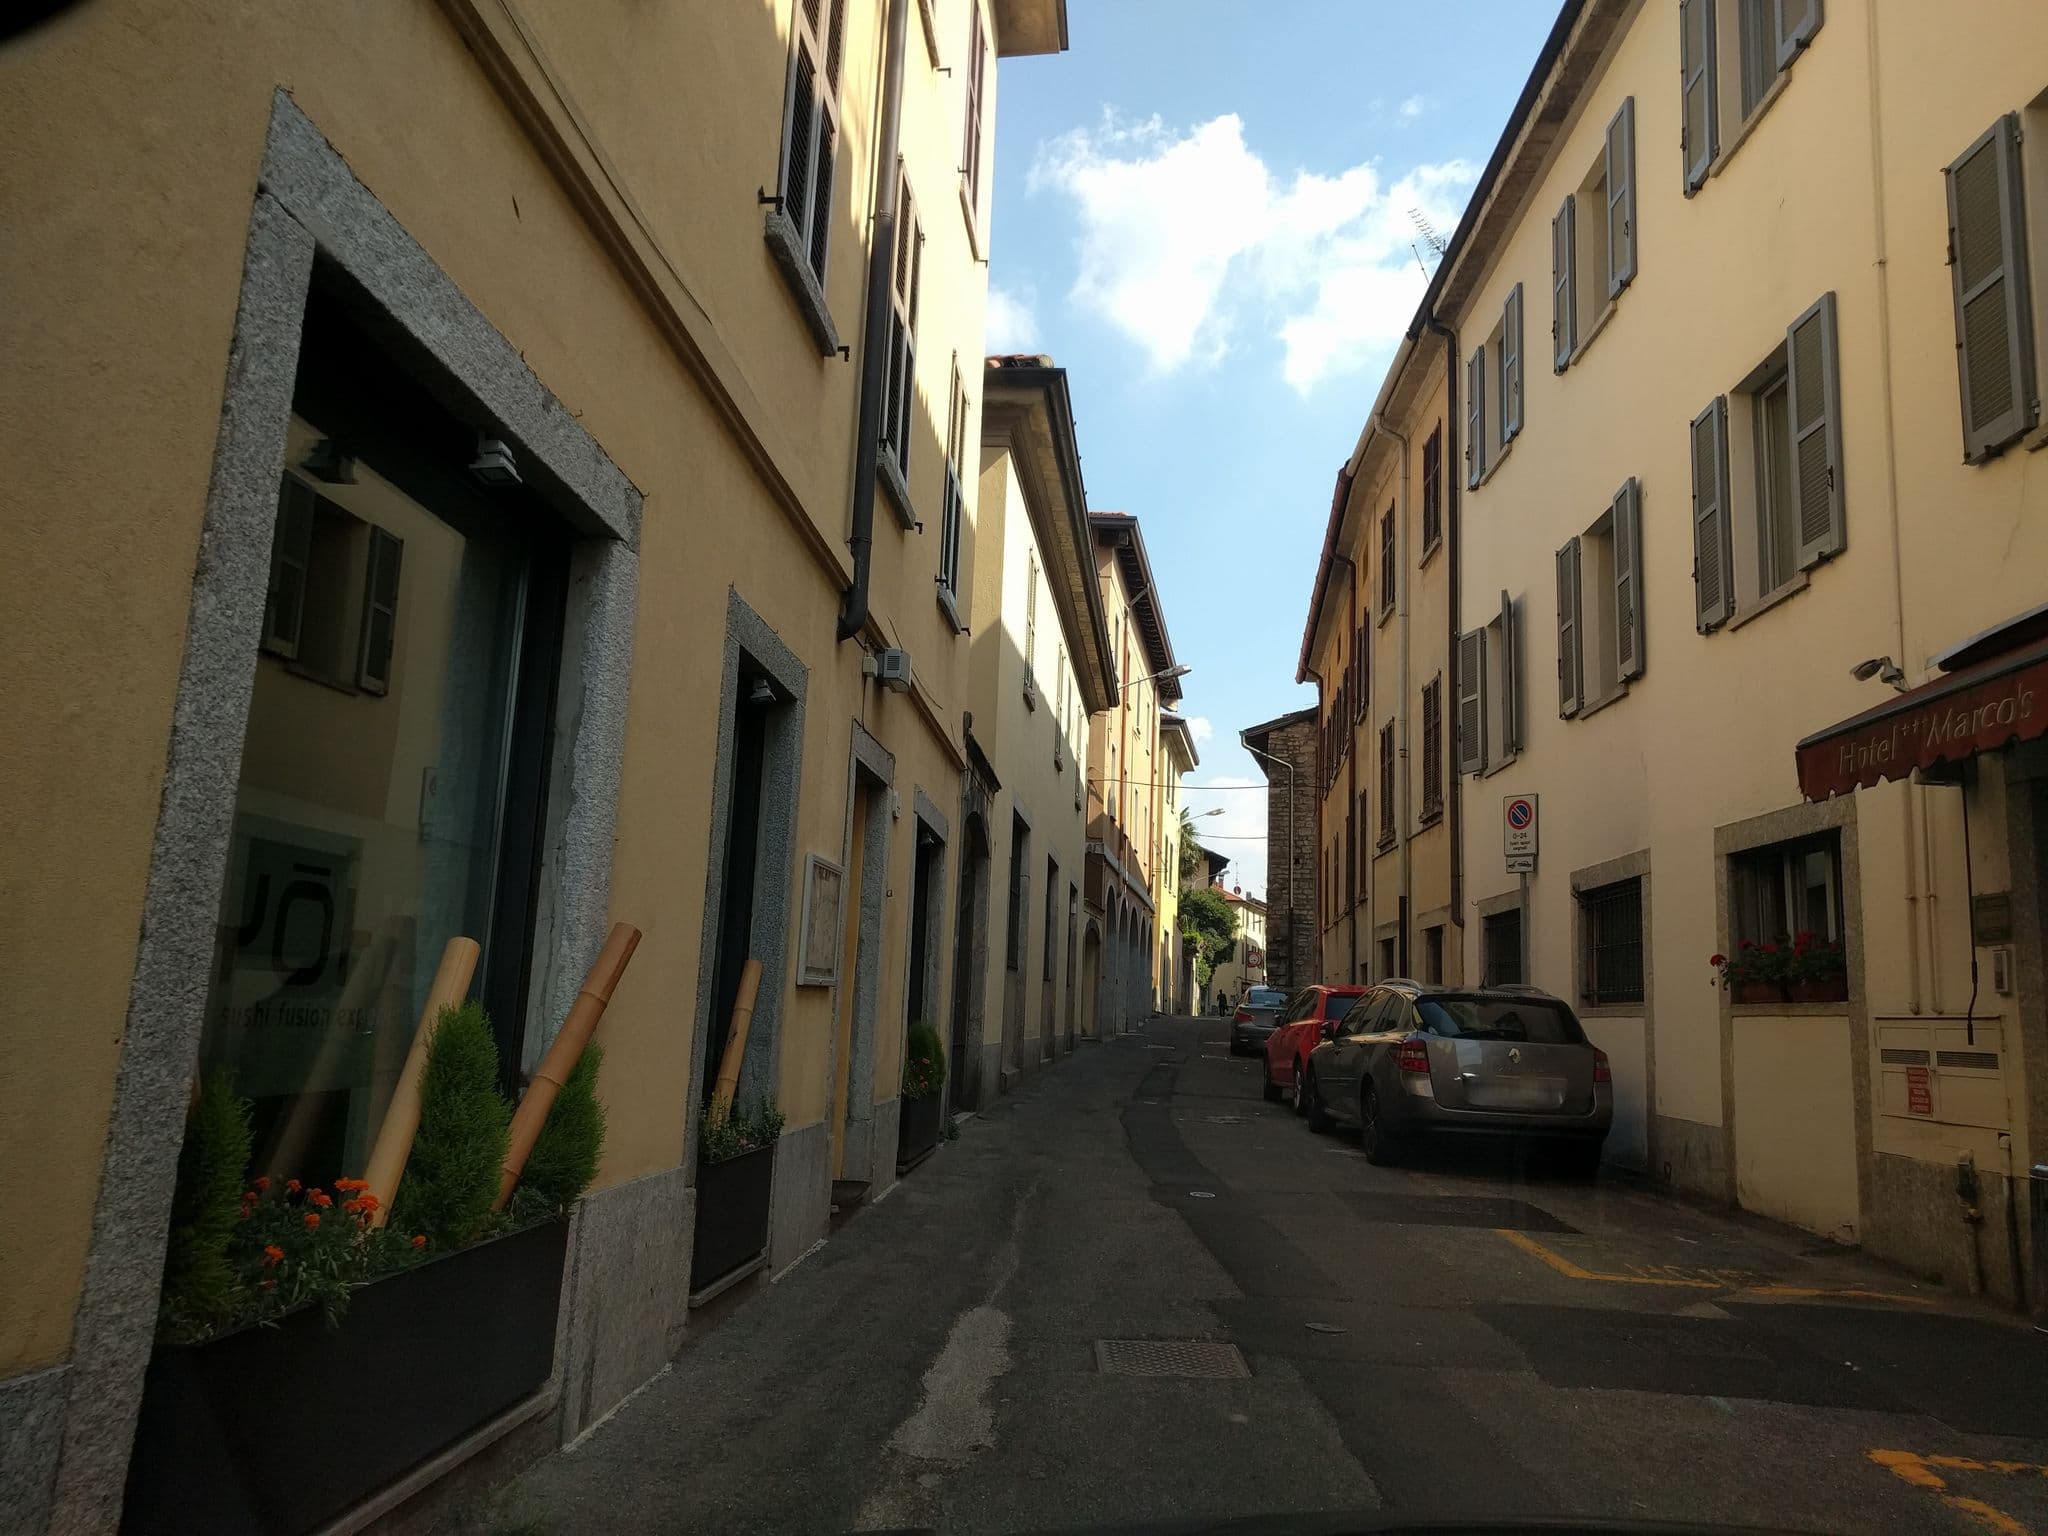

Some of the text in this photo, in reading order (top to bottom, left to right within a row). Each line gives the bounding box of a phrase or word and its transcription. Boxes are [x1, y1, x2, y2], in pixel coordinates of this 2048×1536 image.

[1839, 681, 2034, 776] Hotel Marco's
[221, 1001, 270, 1028] sushi
[279, 1001, 330, 1030] fusion
